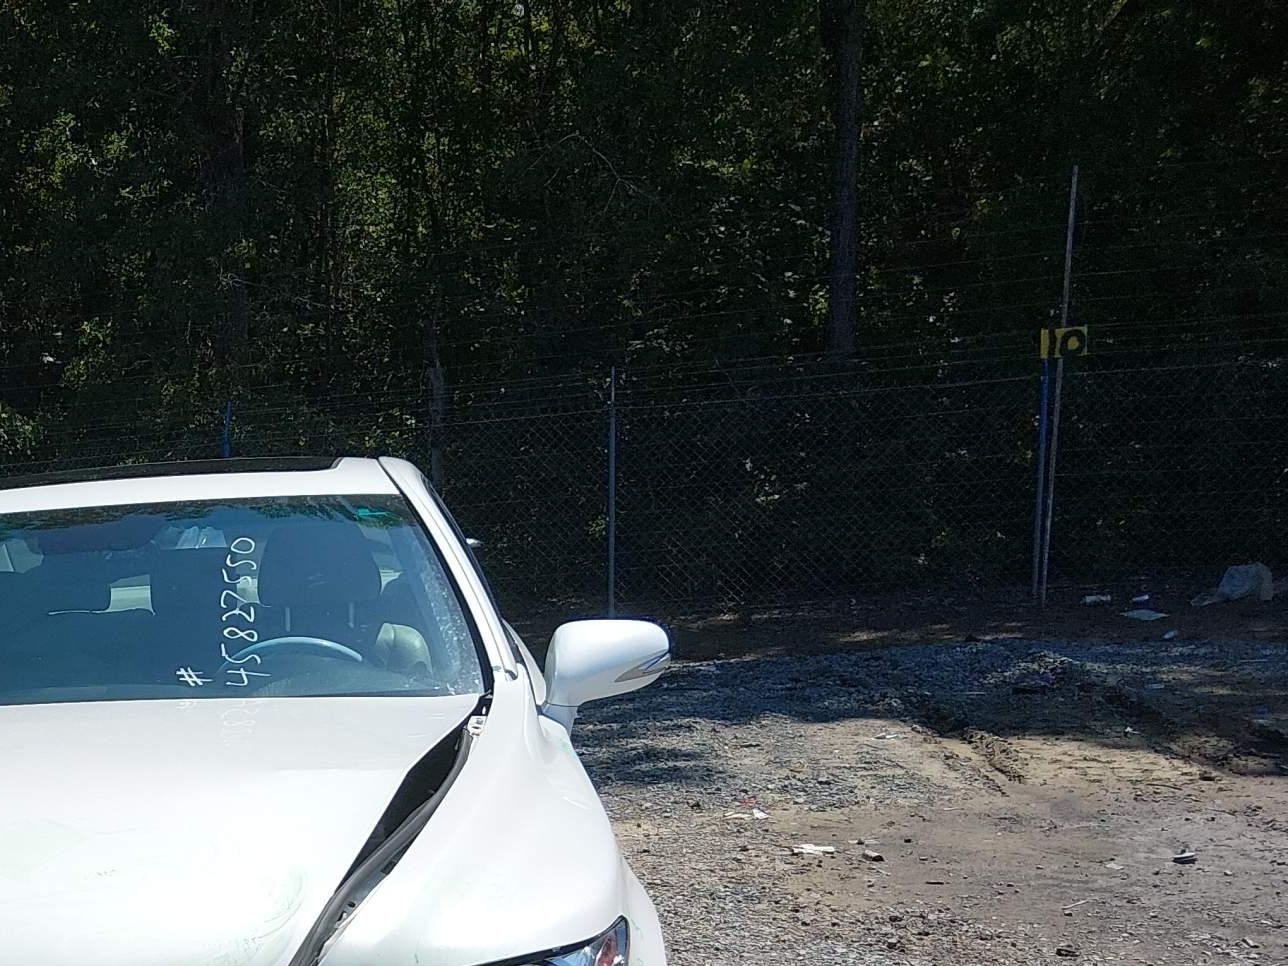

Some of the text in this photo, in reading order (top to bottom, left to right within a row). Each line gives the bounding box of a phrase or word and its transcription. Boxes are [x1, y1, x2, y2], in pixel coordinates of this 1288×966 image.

[1048, 326, 1087, 358] 10
[220, 537, 272, 686] 45827550
[176, 667, 213, 687] #
